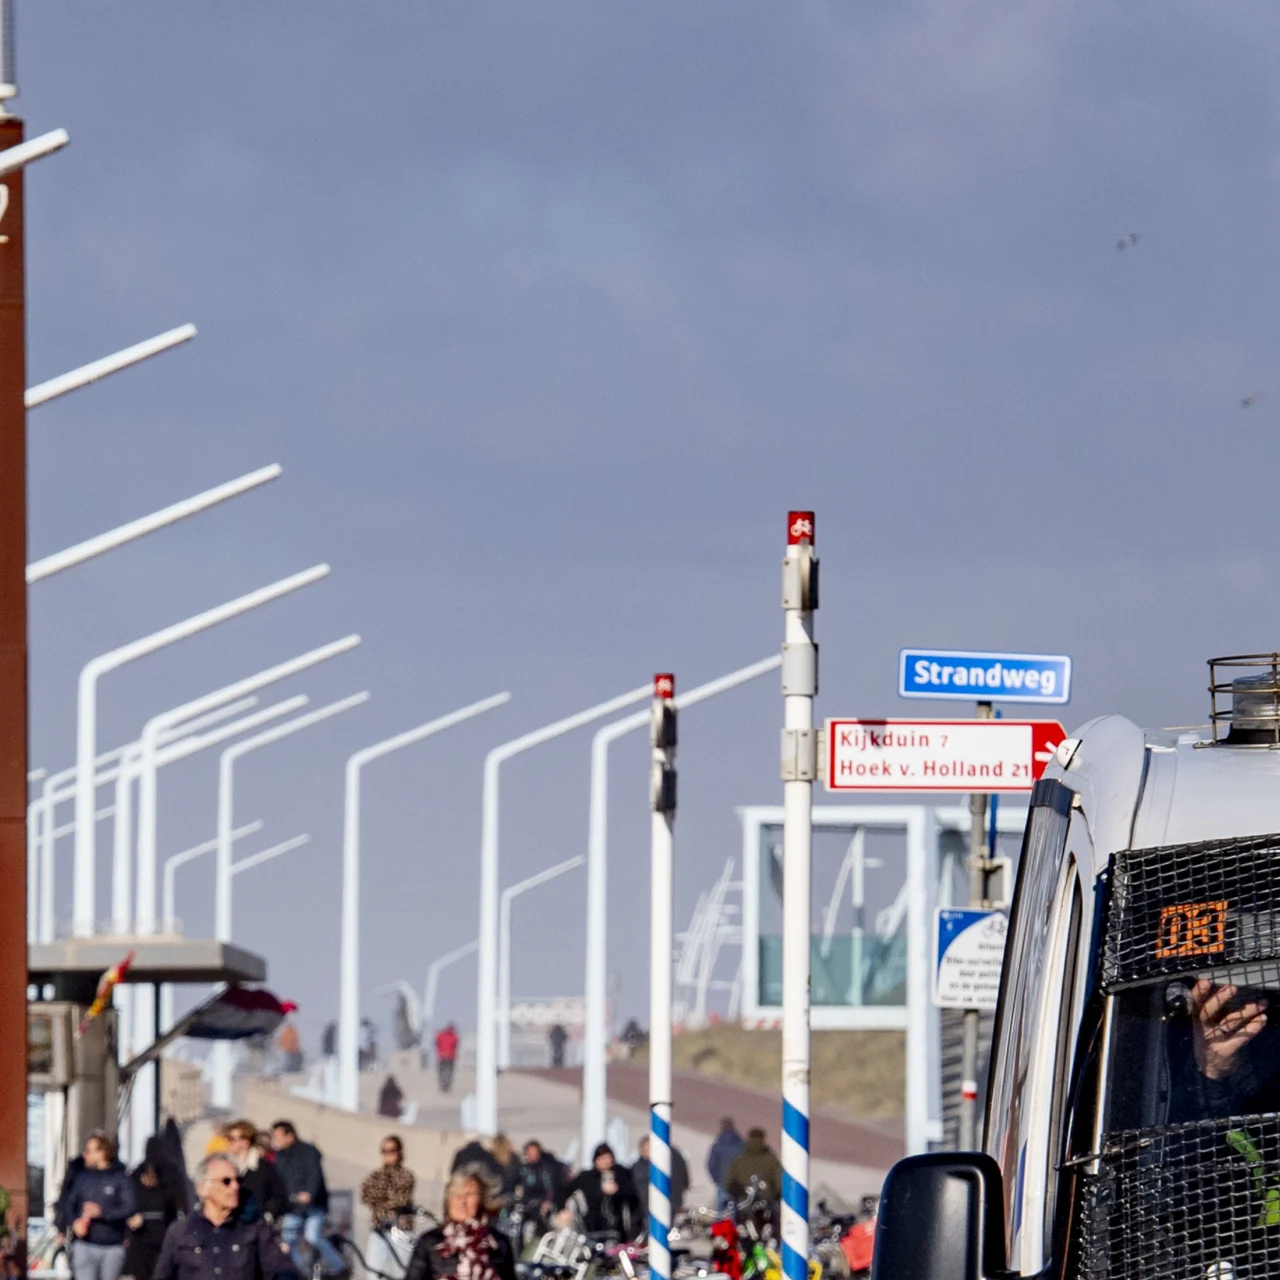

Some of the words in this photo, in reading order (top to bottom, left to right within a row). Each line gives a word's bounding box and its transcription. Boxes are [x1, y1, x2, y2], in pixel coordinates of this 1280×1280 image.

[913, 659, 1057, 695] Strandweg
[841, 730, 930, 751] Kijkduin
[940, 735, 949, 748] 7
[840, 760, 892, 776] Hoek
[900, 764, 916, 776] v.
[924, 760, 1004, 777] Holland
[1011, 763, 1030, 777] 21
